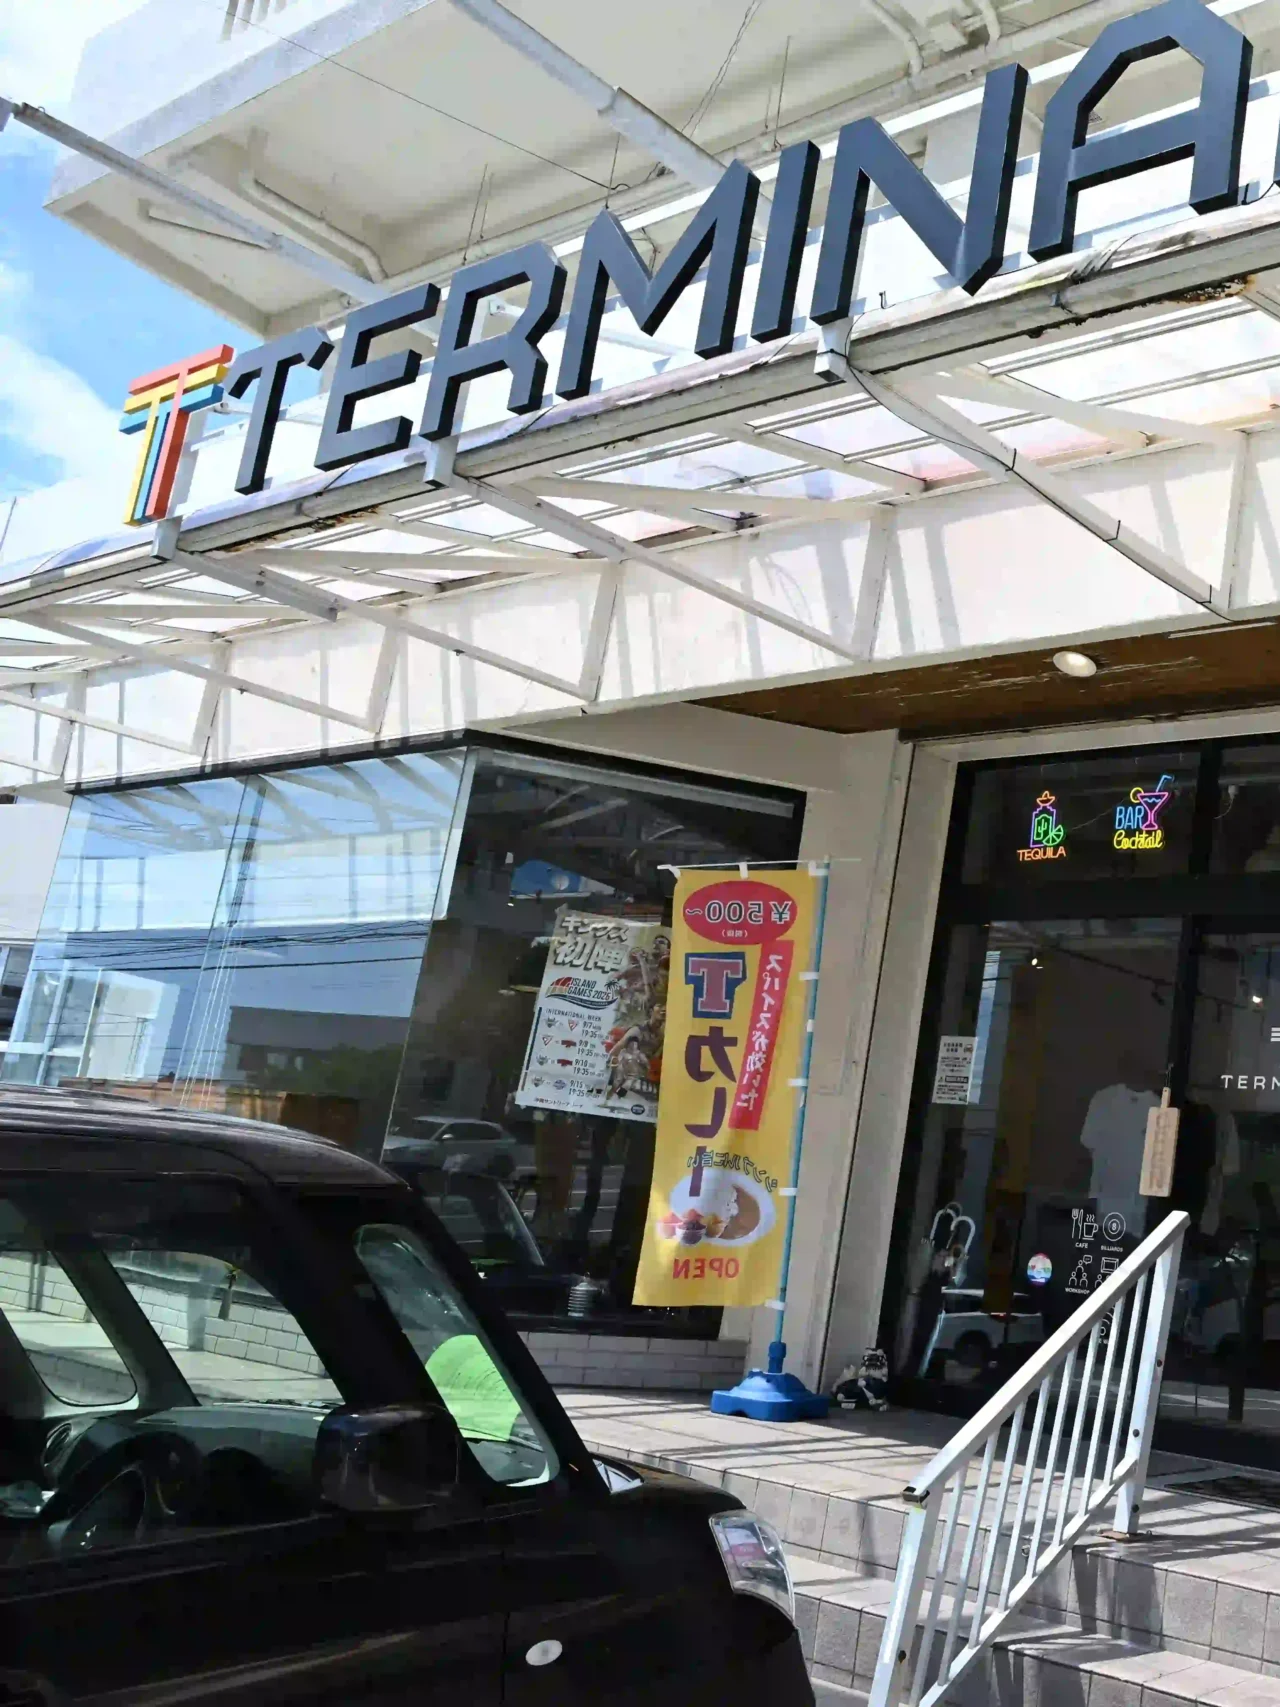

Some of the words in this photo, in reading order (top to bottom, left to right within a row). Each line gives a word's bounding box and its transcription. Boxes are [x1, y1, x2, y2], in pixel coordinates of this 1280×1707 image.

[1115, 806, 1145, 830] BAR
[1113, 830, 1163, 850] Cocktail
[1017, 846, 1067, 861] TEQUILA
[570, 977, 597, 988] ISLAND
[567, 986, 593, 998] GAMES
[1100, 1245, 1124, 1253] BILLIARDS
[1065, 1286, 1090, 1295] WORKSHOP
